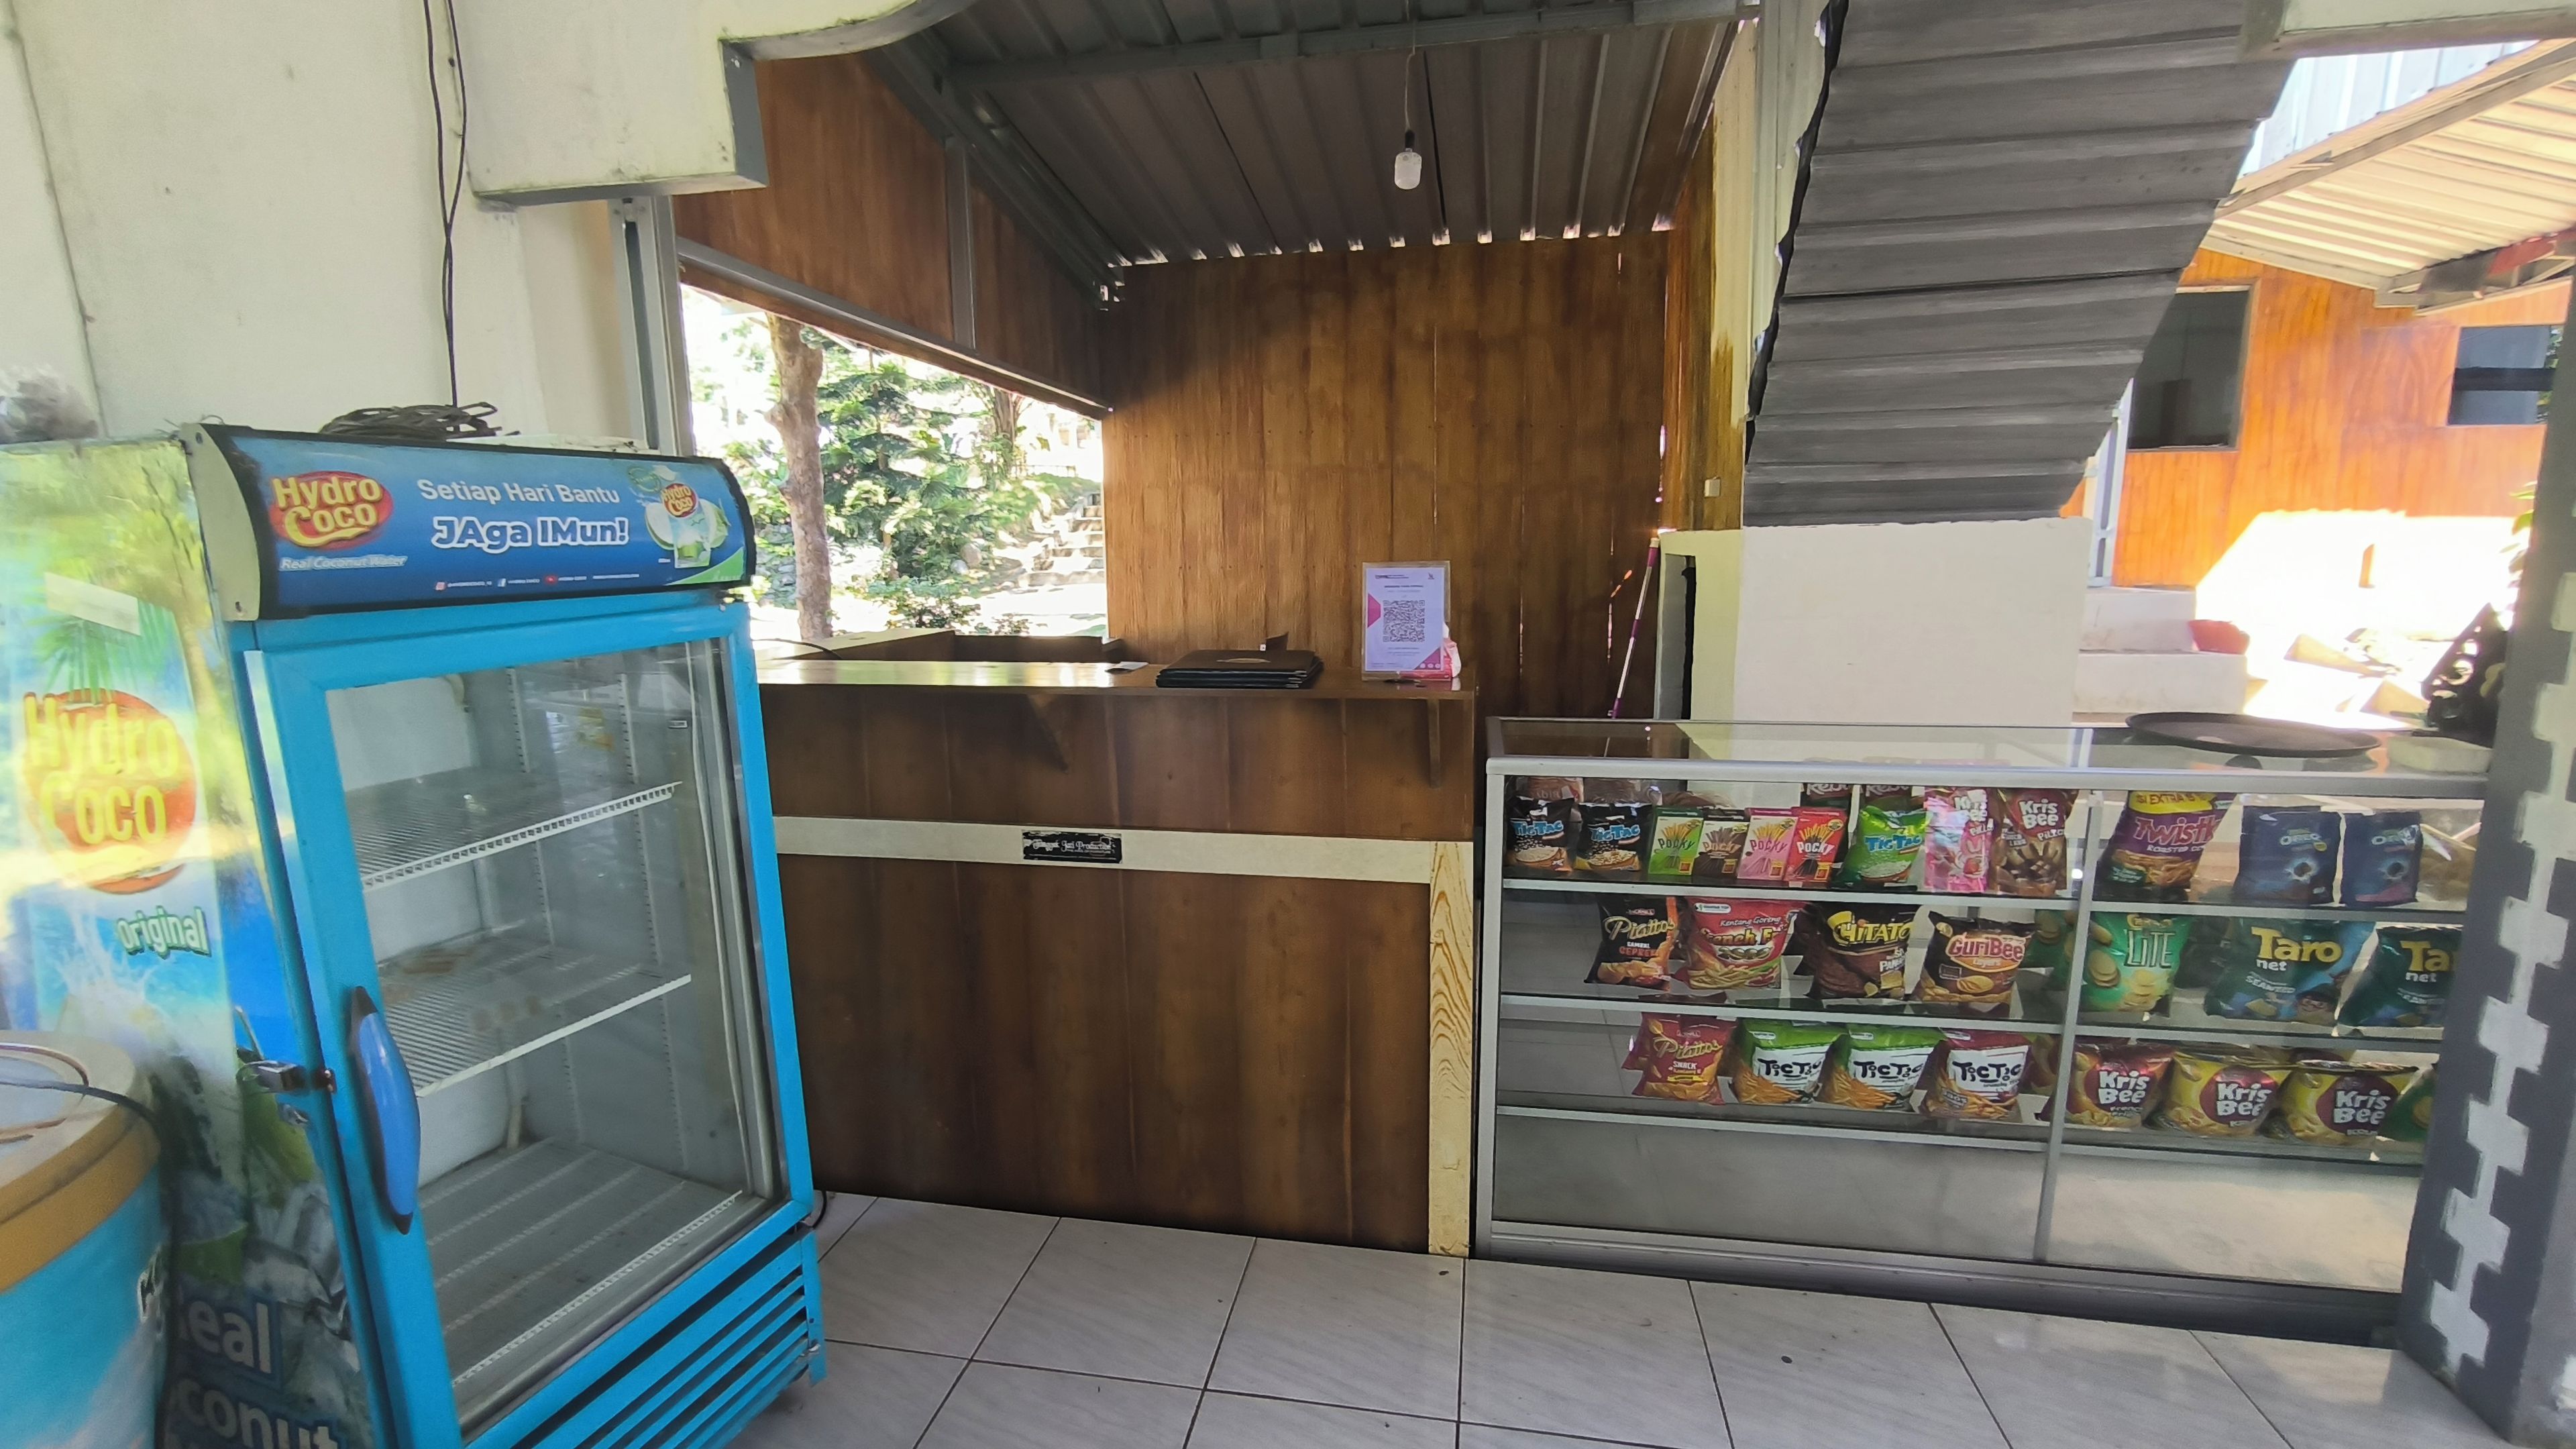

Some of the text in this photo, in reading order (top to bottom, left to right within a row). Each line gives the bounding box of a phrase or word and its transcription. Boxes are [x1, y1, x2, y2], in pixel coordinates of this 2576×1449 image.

[272, 476, 382, 509] Hydro
[417, 479, 620, 504] Setiap Hari Bantu
[661, 485, 692, 501] Hydro
[671, 497, 693, 516] Coco
[284, 502, 378, 547] Coco
[431, 517, 532, 553] JAga
[279, 555, 407, 570] Real Coconut Water
[24, 693, 178, 778] Hydro
[2019, 798, 2058, 815] Kris
[40, 771, 168, 865] Coco
[2022, 814, 2059, 829] Bee
[2251, 926, 2342, 963] Taro
[2256, 959, 2287, 971] net
[2406, 972, 2436, 983] net
[1653, 1036, 1723, 1059] Piattos
[2099, 1070, 2150, 1090] Kris
[2098, 1088, 2146, 1104] Bee
[2217, 1083, 2273, 1102] Kris
[2336, 1089, 2392, 1110] Kris
[2216, 1100, 2265, 1116] Bee
[2333, 1108, 2386, 1124] Bee
[181, 1295, 271, 1374] eal
